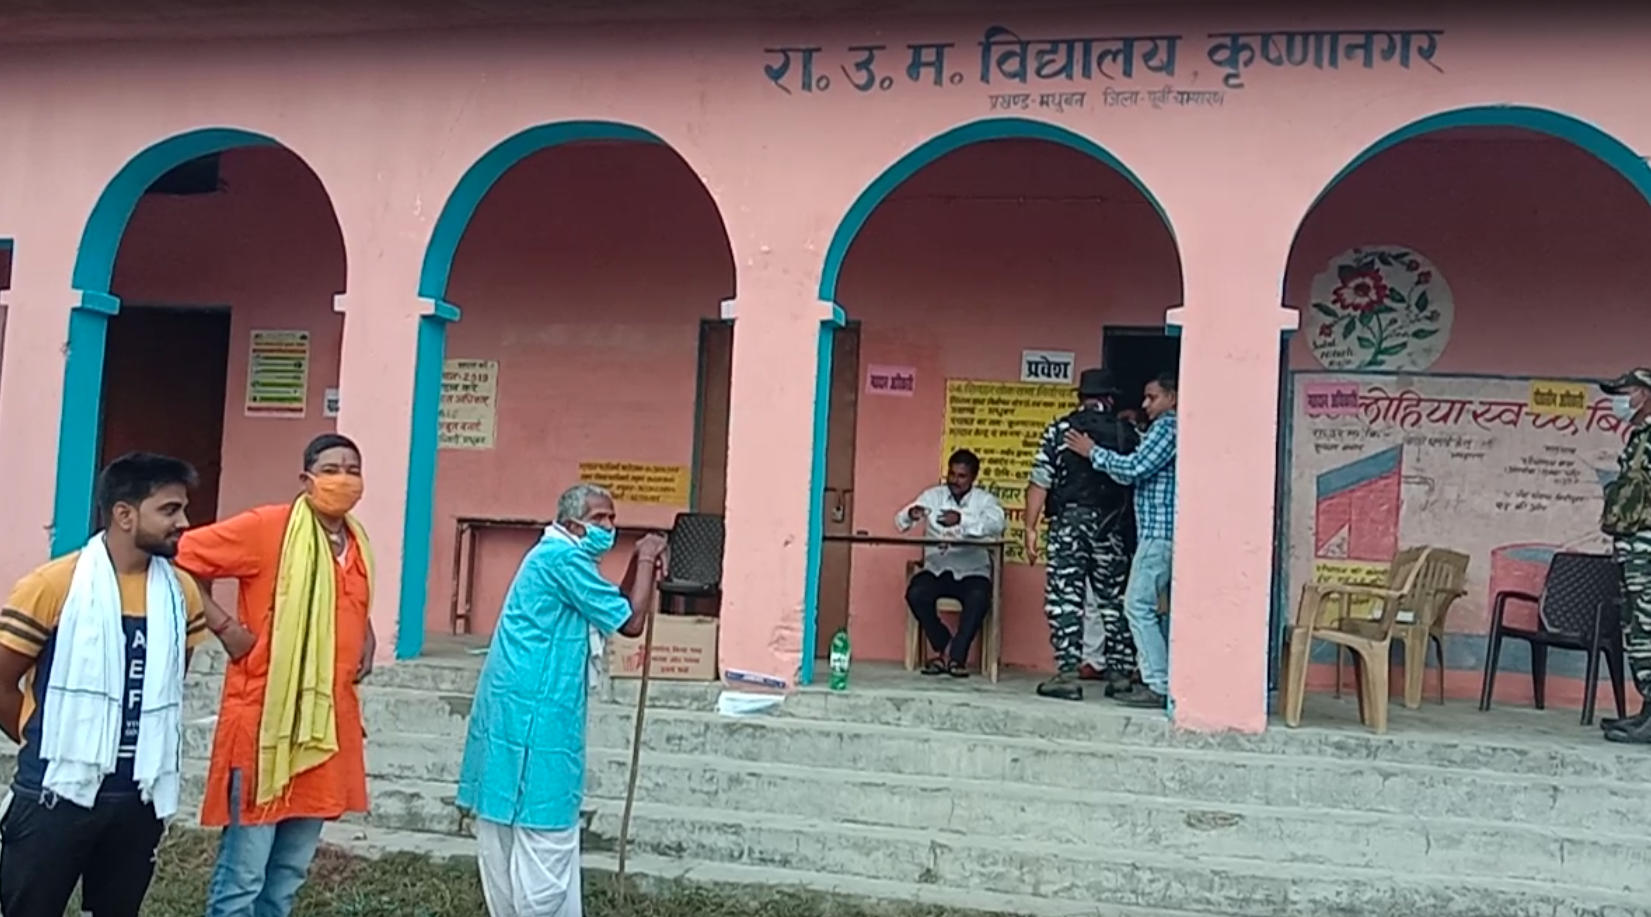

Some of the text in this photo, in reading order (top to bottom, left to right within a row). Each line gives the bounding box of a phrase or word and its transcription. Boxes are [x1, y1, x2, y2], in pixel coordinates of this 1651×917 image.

[1206, 29, 1445, 89] कृष्णानगर
[1026, 354, 1071, 379] प्रवेश
[1357, 386, 1474, 431] लोहिया
